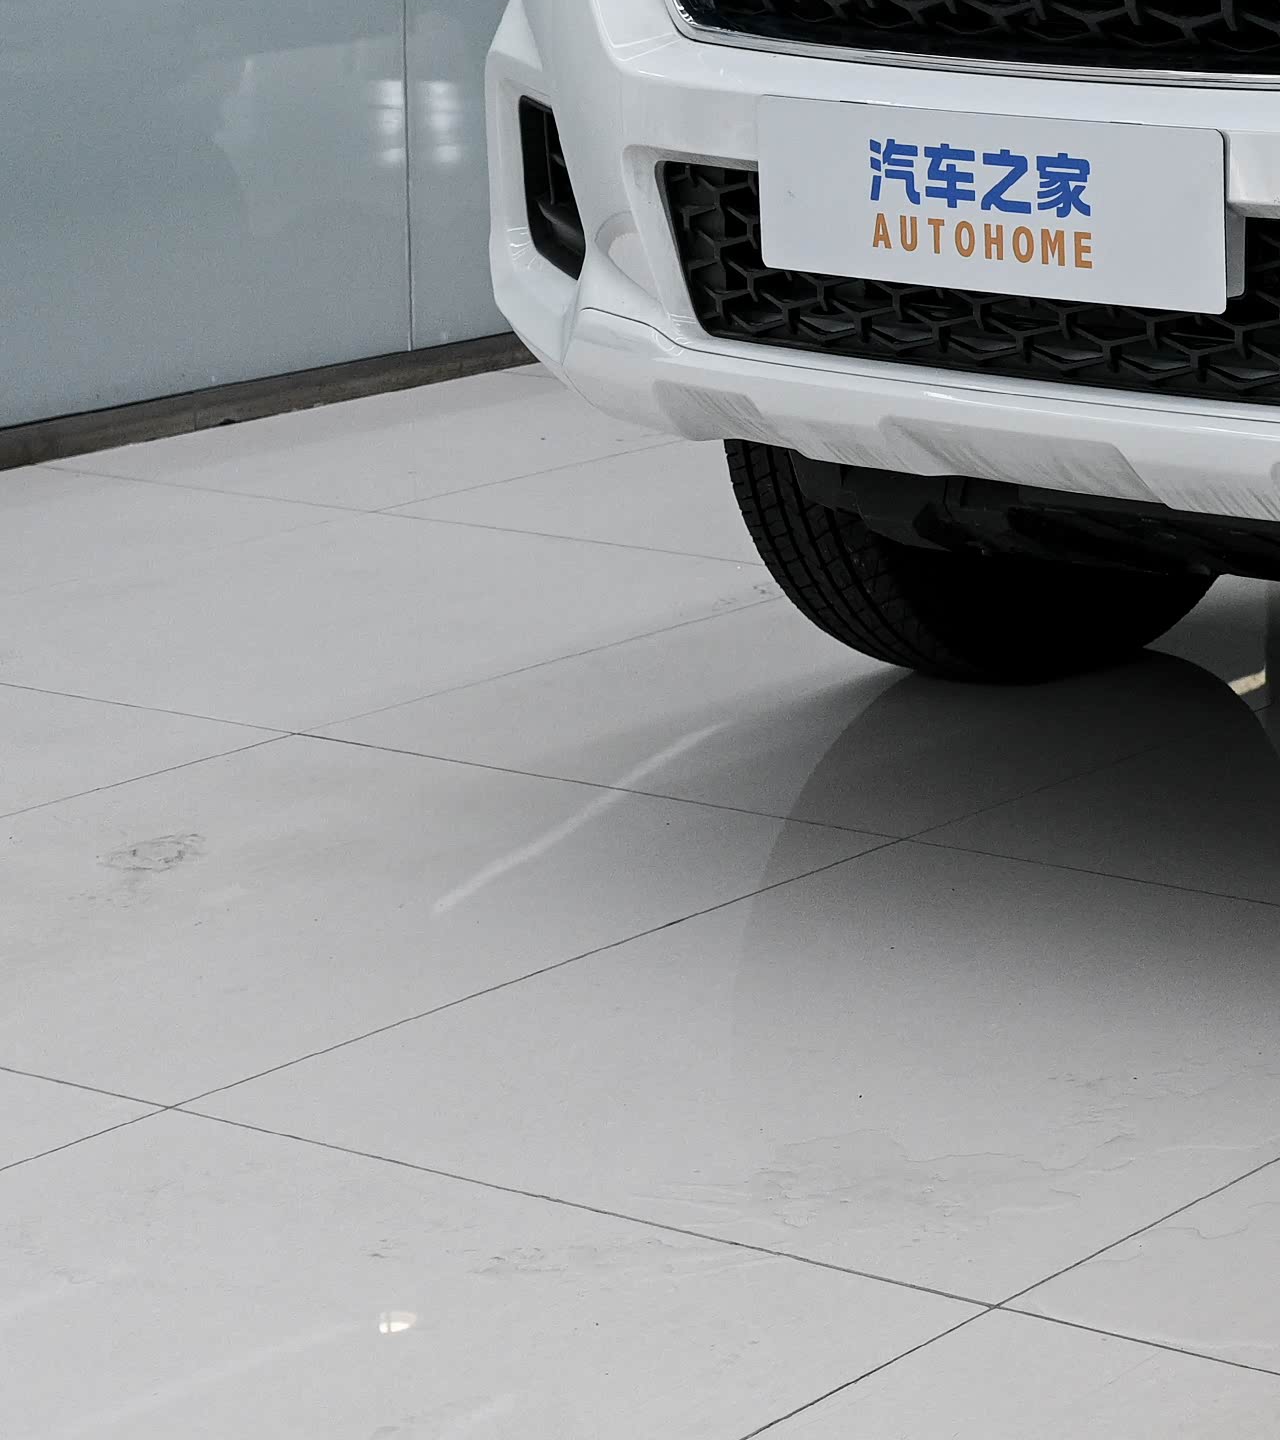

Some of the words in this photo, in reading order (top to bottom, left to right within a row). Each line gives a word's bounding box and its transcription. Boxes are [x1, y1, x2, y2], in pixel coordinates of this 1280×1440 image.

[869, 138, 1091, 218] 汽车之家
[872, 212, 1094, 270] AUTOHOME
